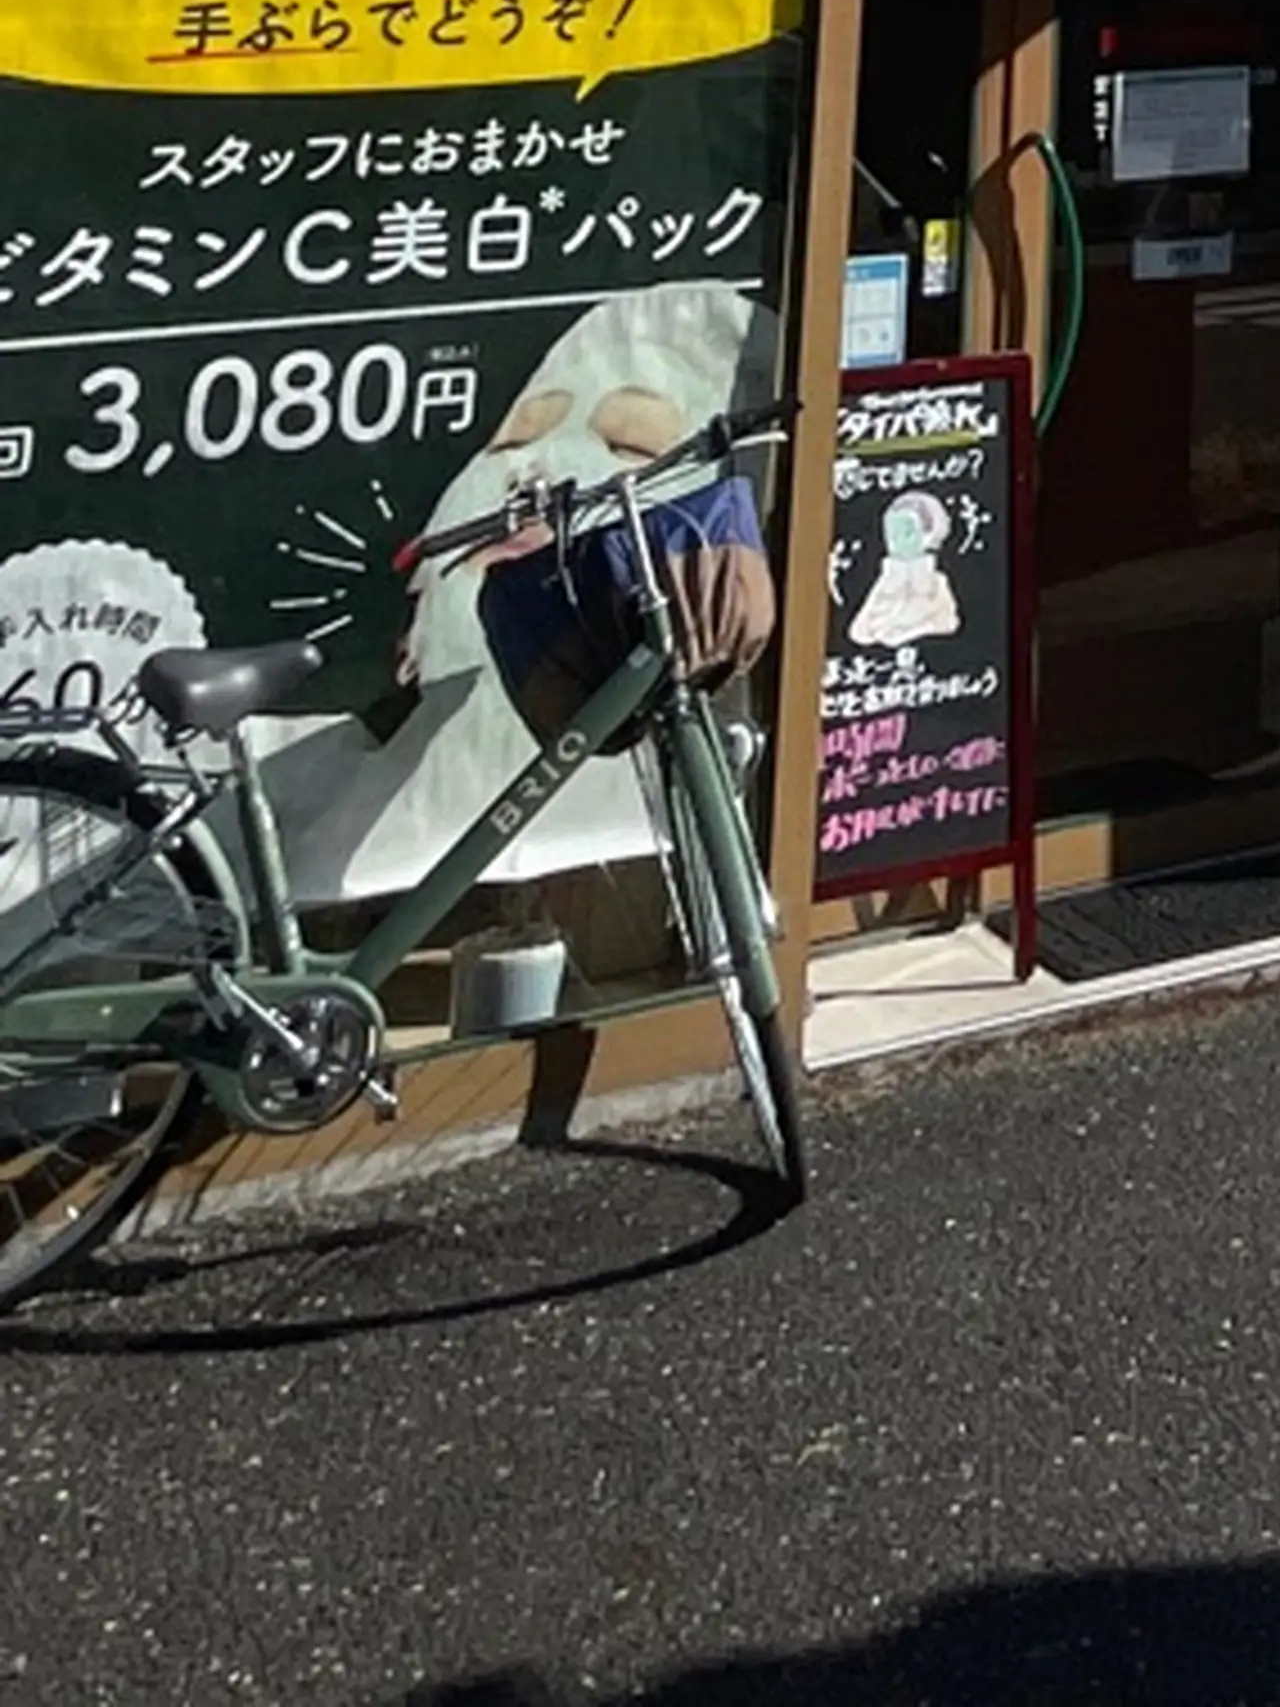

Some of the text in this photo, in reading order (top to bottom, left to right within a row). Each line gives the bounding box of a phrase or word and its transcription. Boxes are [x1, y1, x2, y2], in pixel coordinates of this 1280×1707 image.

[139, 118, 627, 189] スタッフにおまかせ
